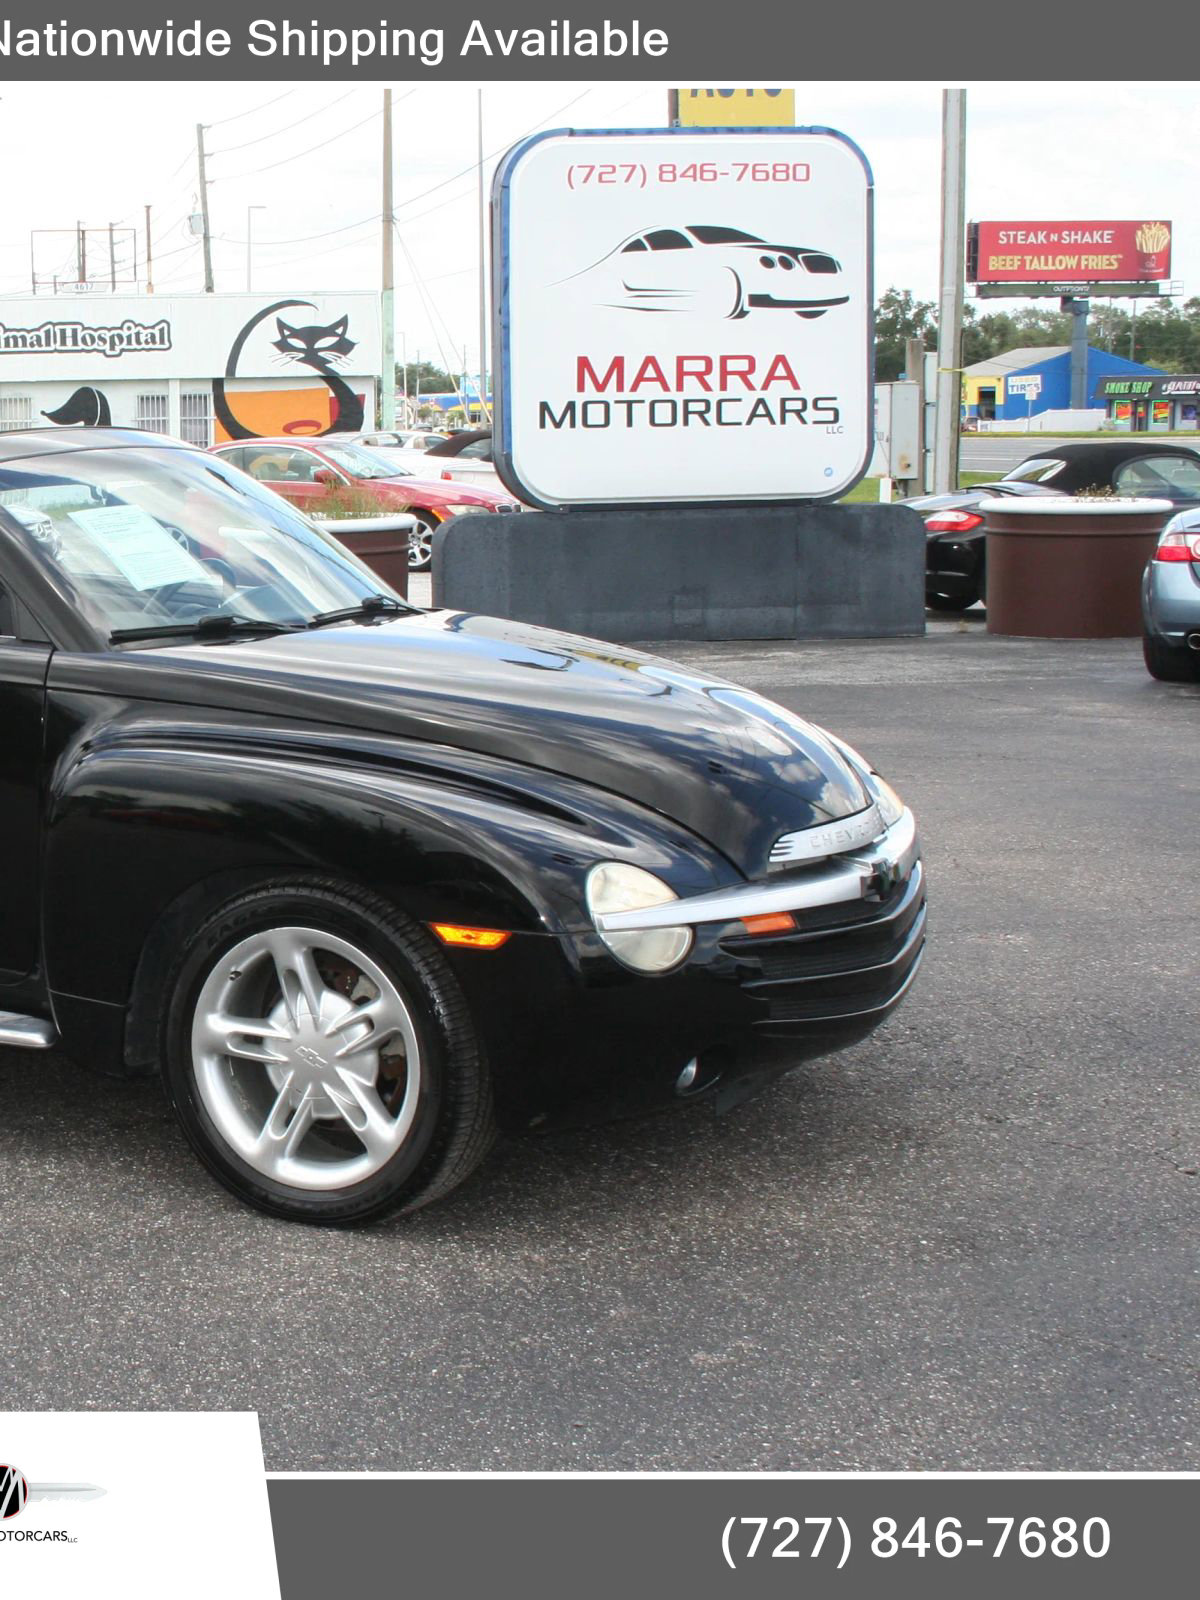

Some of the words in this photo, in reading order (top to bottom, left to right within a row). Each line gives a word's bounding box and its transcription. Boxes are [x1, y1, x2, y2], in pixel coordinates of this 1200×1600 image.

[567, 163, 647, 189] (727)
[658, 162, 811, 183] 846-7680
[998, 230, 1047, 245] STEAK
[1050, 232, 1058, 243] N
[1061, 230, 1113, 244] SHAKE
[988, 255, 1021, 271] BEEF
[1024, 254, 1079, 271] TALLOW
[1081, 254, 1119, 270] FRIES
[56, 322, 169, 354] Hospital
[577, 354, 801, 393] MARRA
[1131, 381, 1153, 394] SHOP
[539, 396, 840, 430] MOTORCARS
[826, 425, 844, 434] LLC
